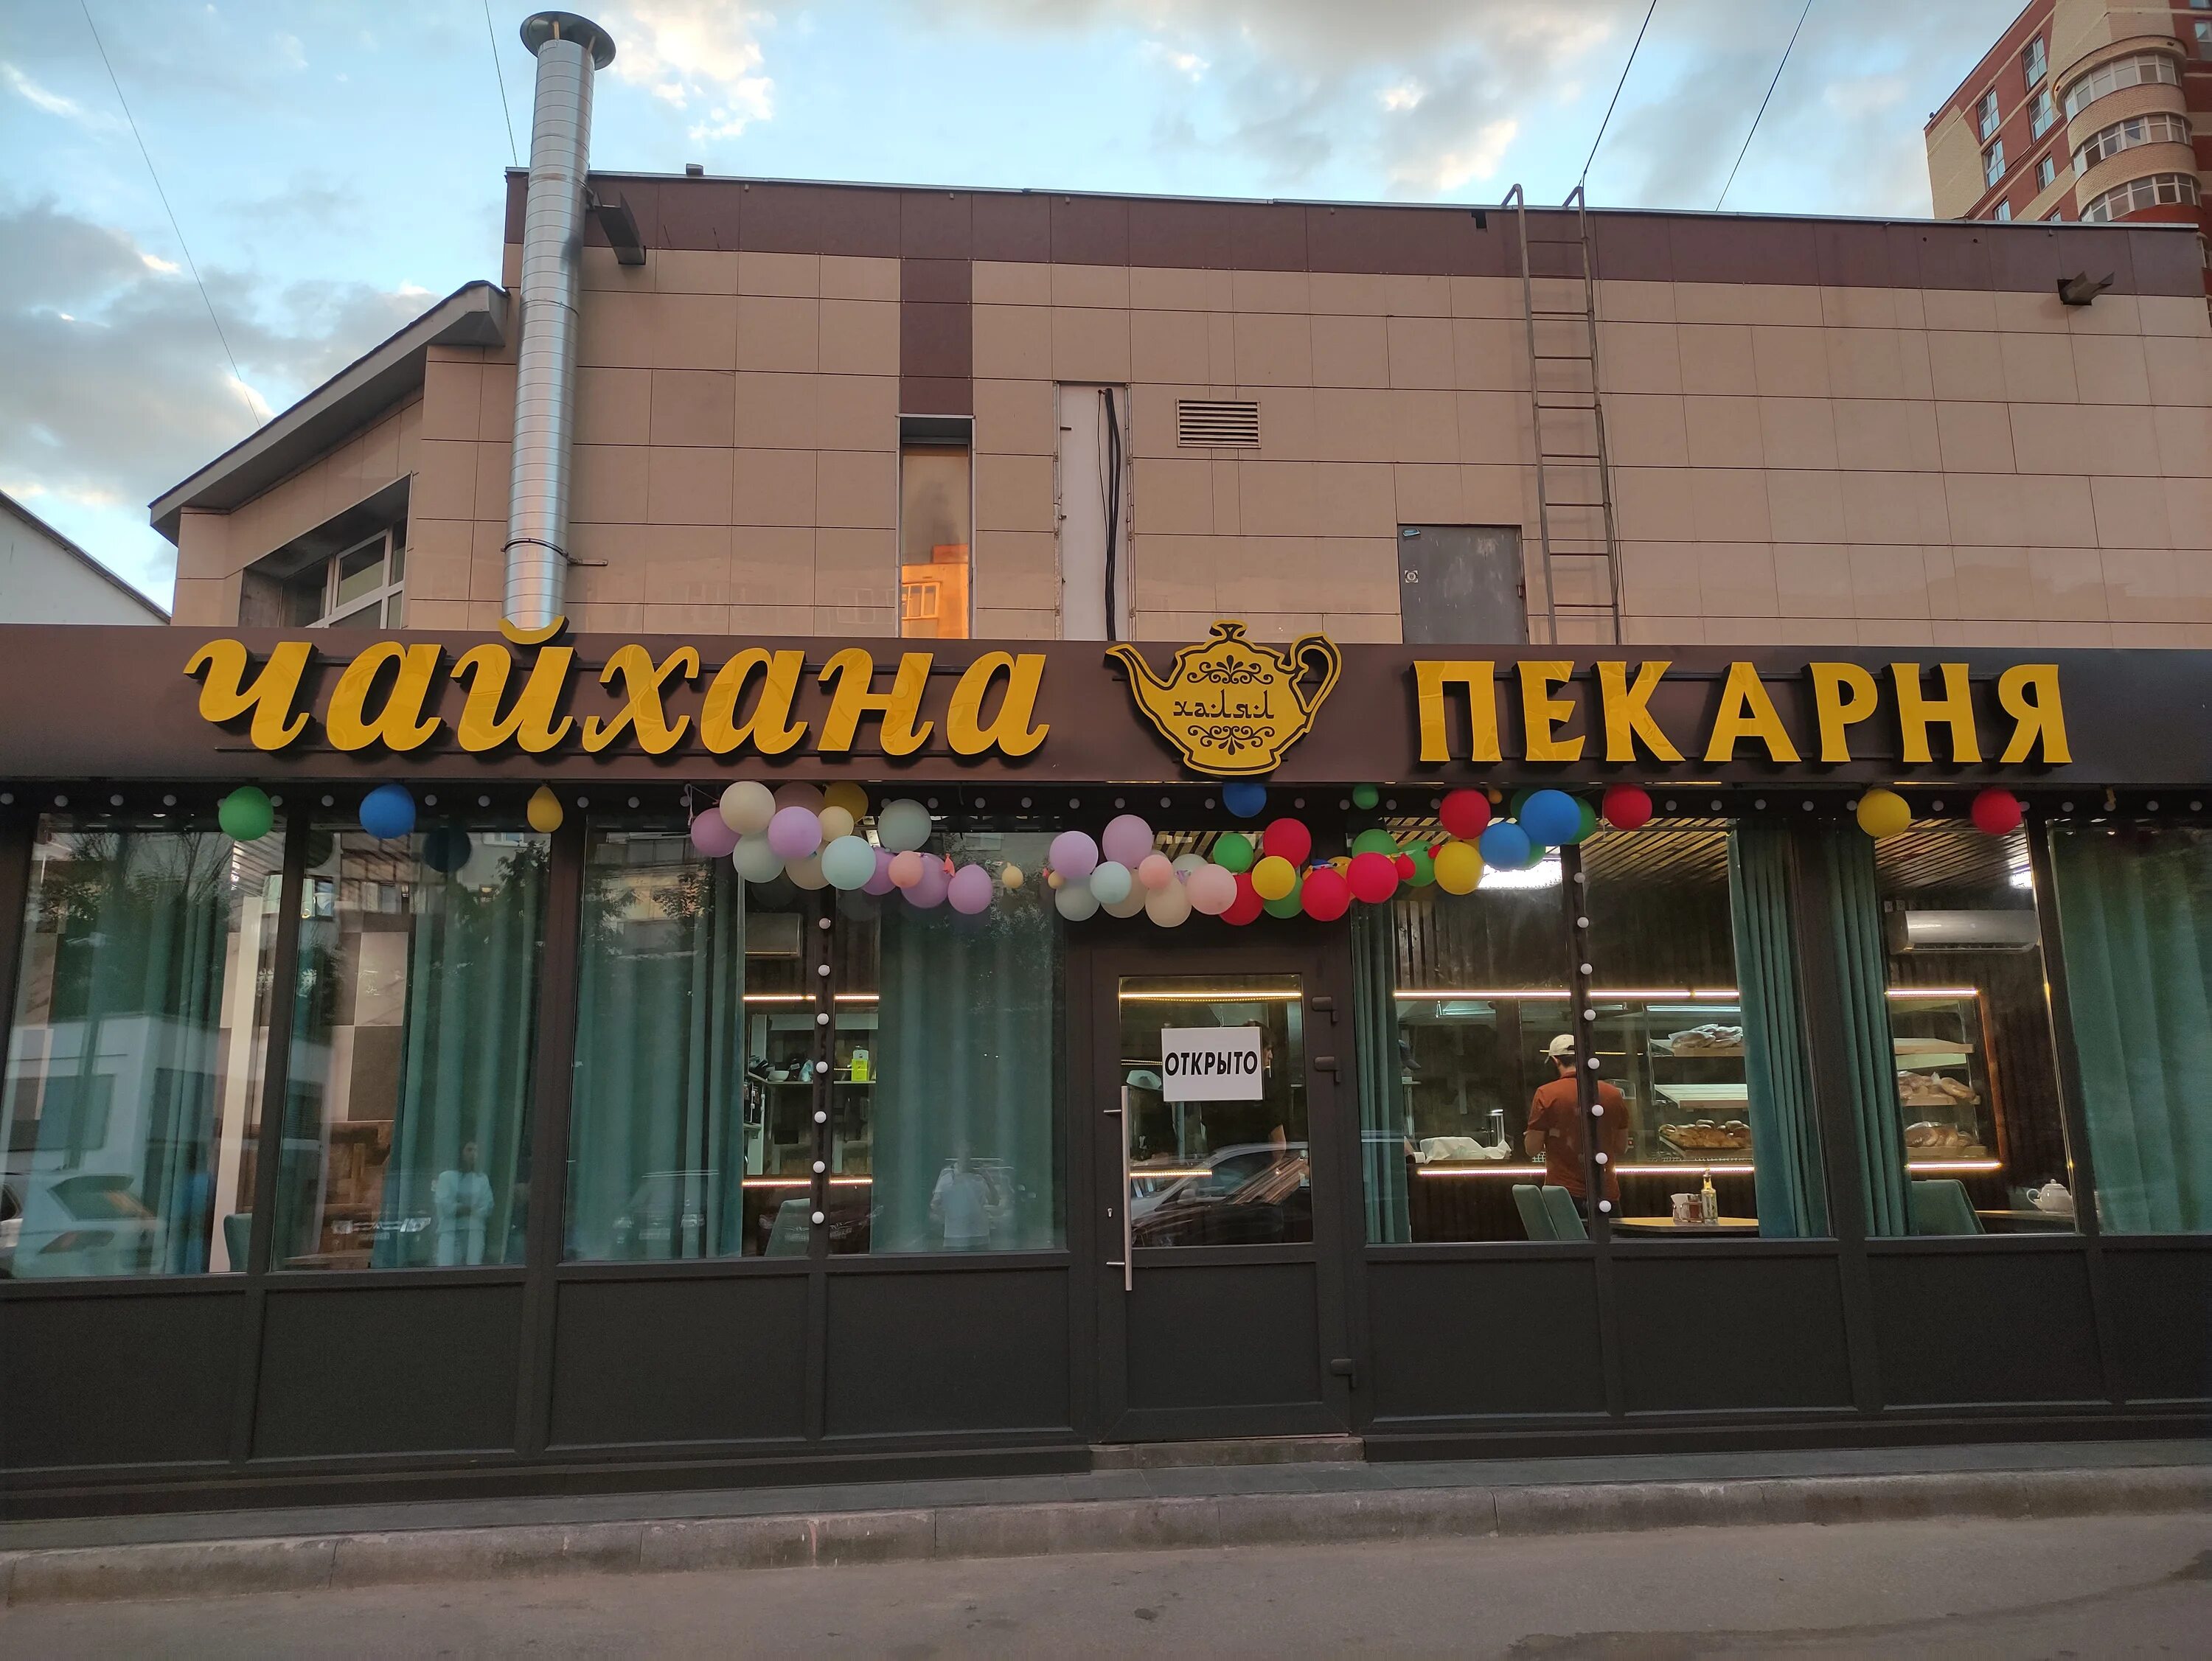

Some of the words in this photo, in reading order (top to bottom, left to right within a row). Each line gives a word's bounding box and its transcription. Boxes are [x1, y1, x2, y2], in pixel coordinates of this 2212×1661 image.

[183, 615, 1050, 756] чайхана
[1413, 660, 2073, 764] ПЕКАРНЯ
[1164, 1051, 1258, 1076] ОТКРЫТО
